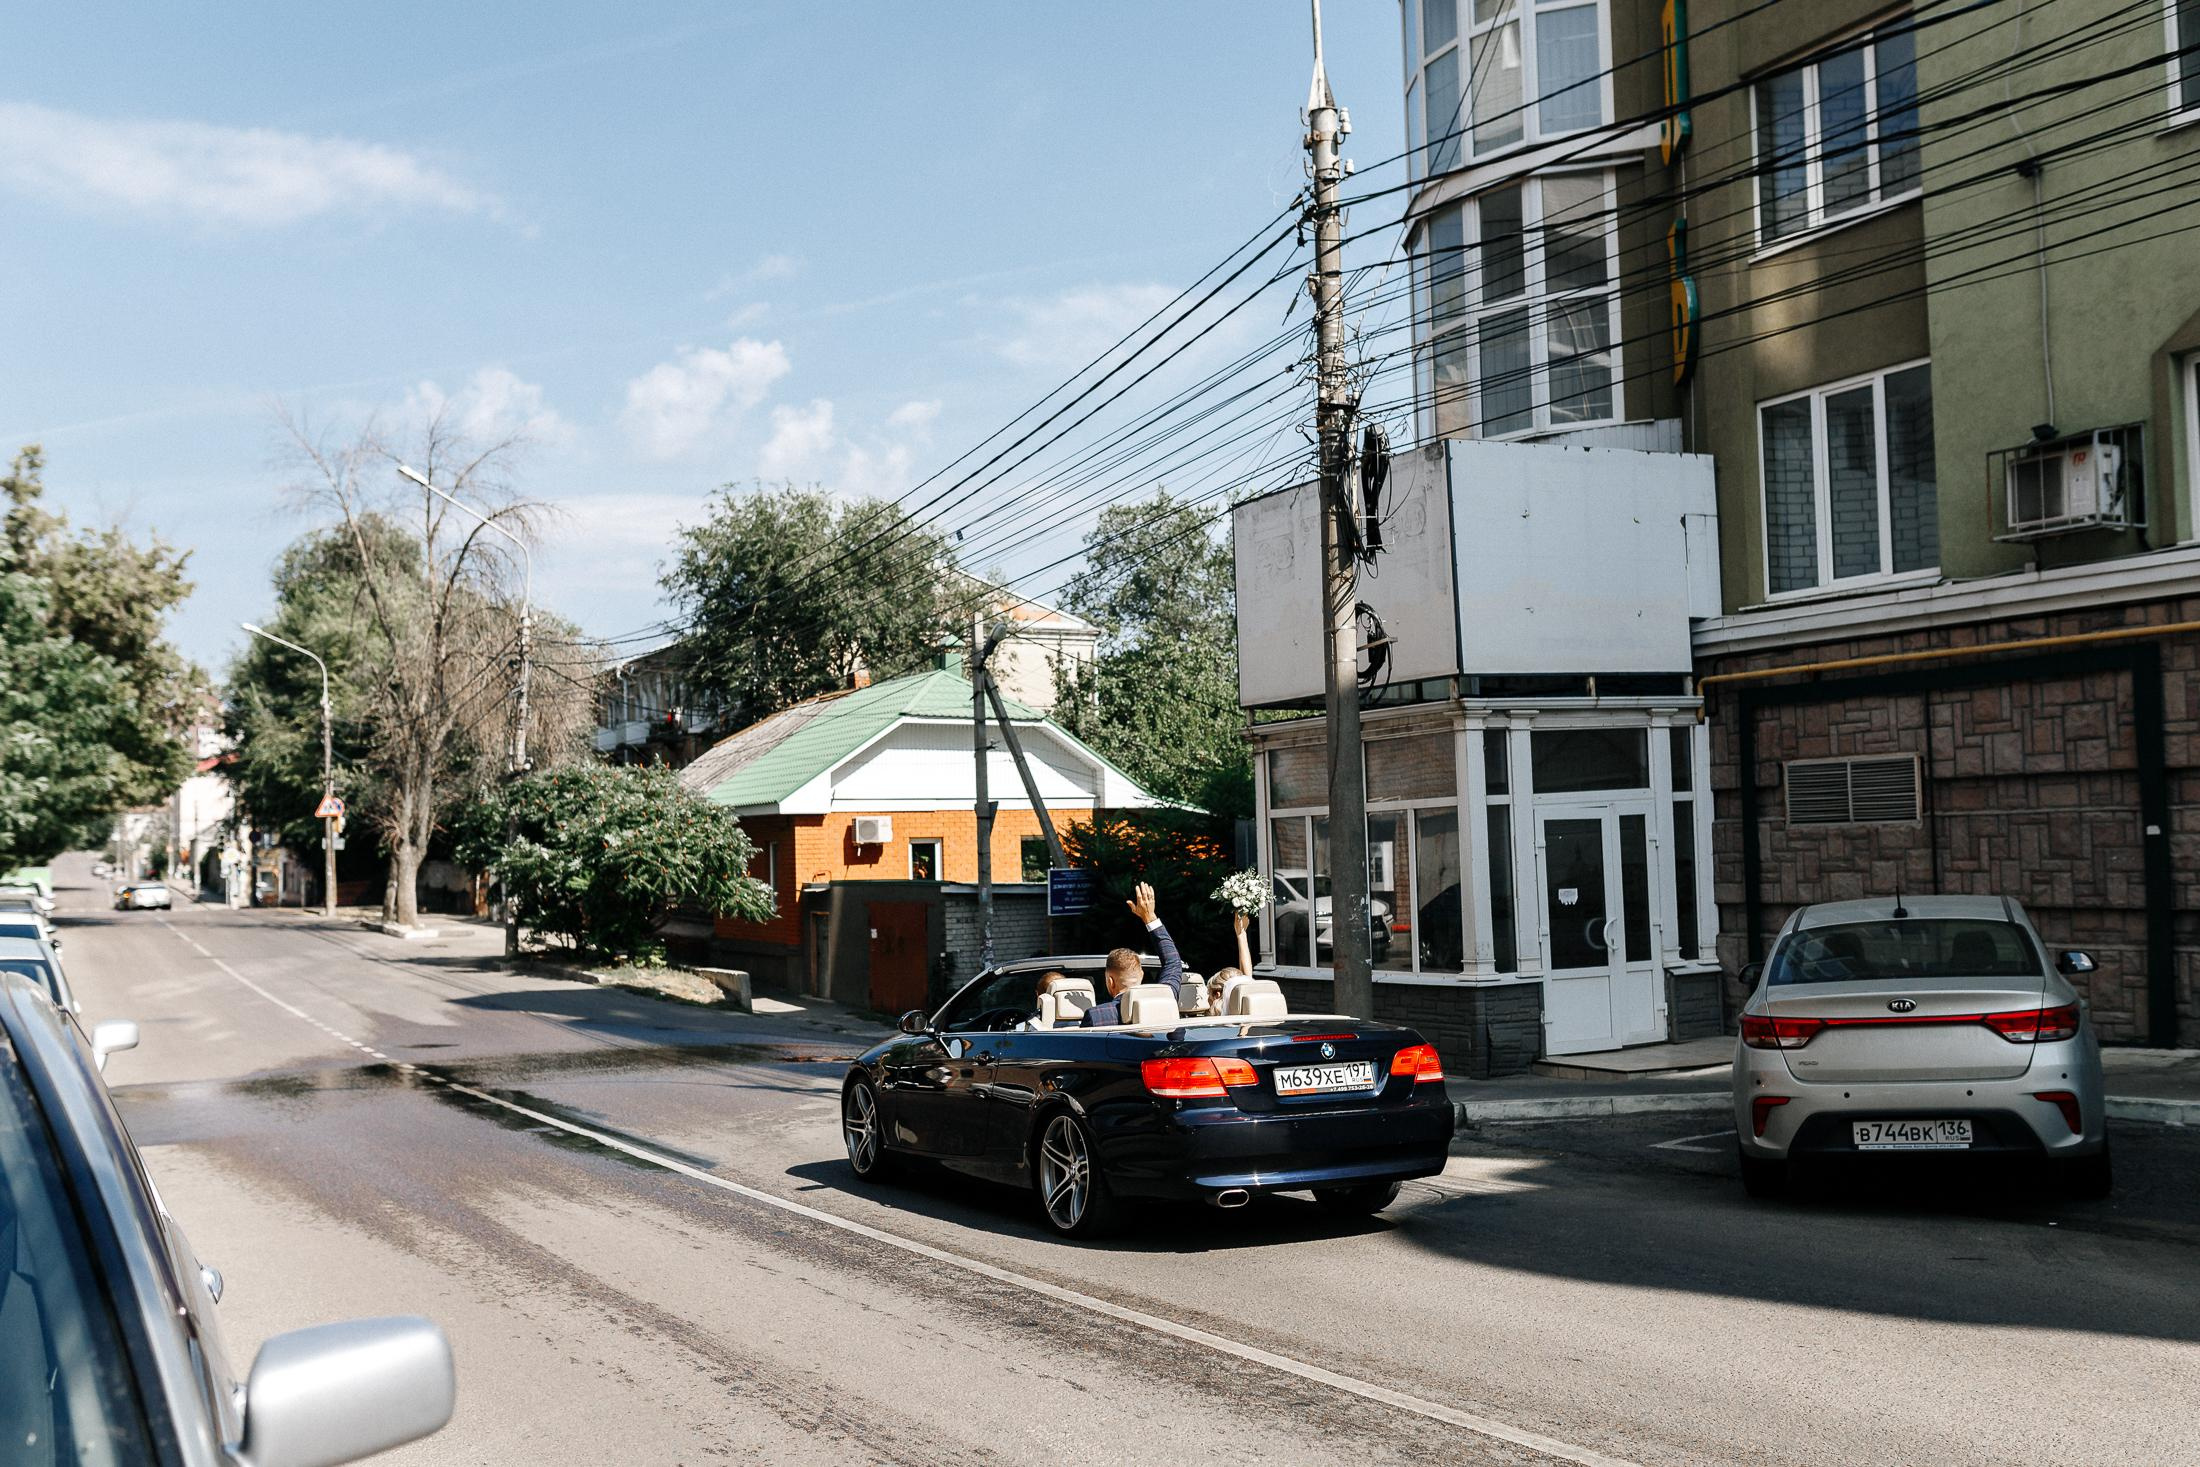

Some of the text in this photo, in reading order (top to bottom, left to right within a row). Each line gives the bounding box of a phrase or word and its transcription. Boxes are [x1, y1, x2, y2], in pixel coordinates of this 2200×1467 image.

[1891, 1001, 1912, 1010] KIA
[1280, 1062, 1367, 1088] М639ХЕ 197
[1859, 1121, 1965, 1142] В744ВК 136
